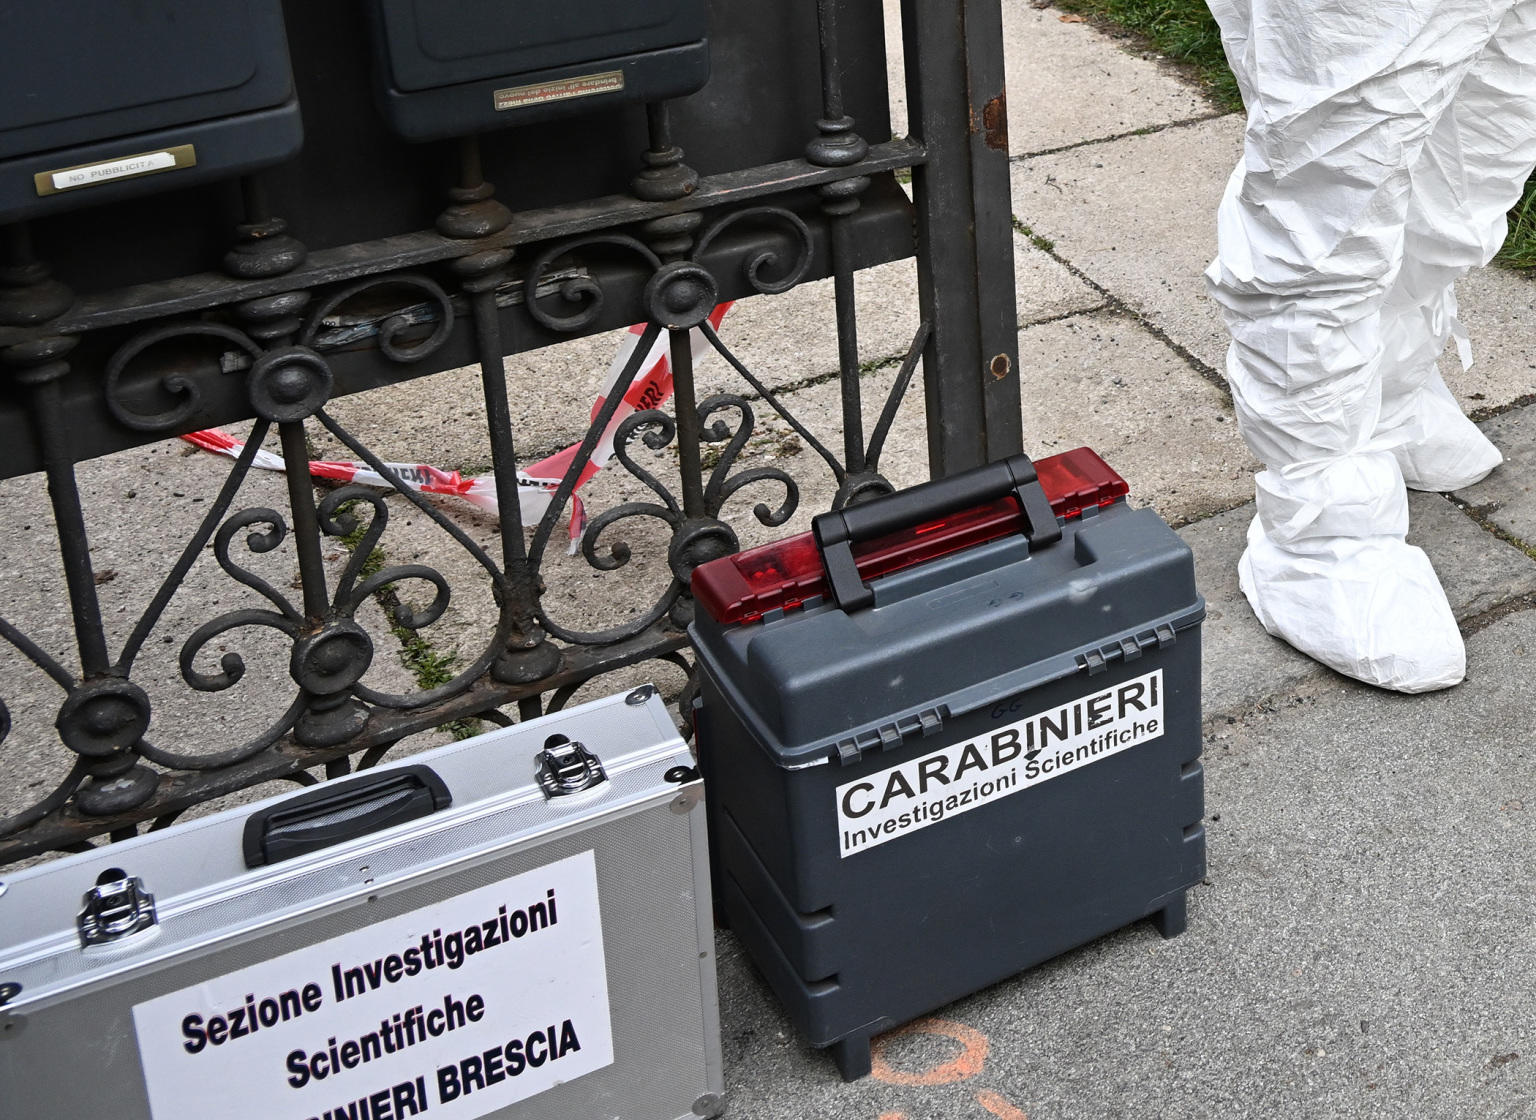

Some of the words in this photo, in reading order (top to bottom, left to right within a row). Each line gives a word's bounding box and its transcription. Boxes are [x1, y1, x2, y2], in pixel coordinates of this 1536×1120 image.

[68, 173, 85, 183] NO
[841, 675, 1159, 819] CARABINIERI
[843, 767, 1018, 851] Investigazioni
[1024, 718, 1159, 781] Scientifiche
[181, 981, 323, 1055] Sezione
[330, 888, 559, 1004] Investigazioni
[285, 991, 486, 1089] Scientifiche
[436, 1018, 582, 1105] BRESCIA
